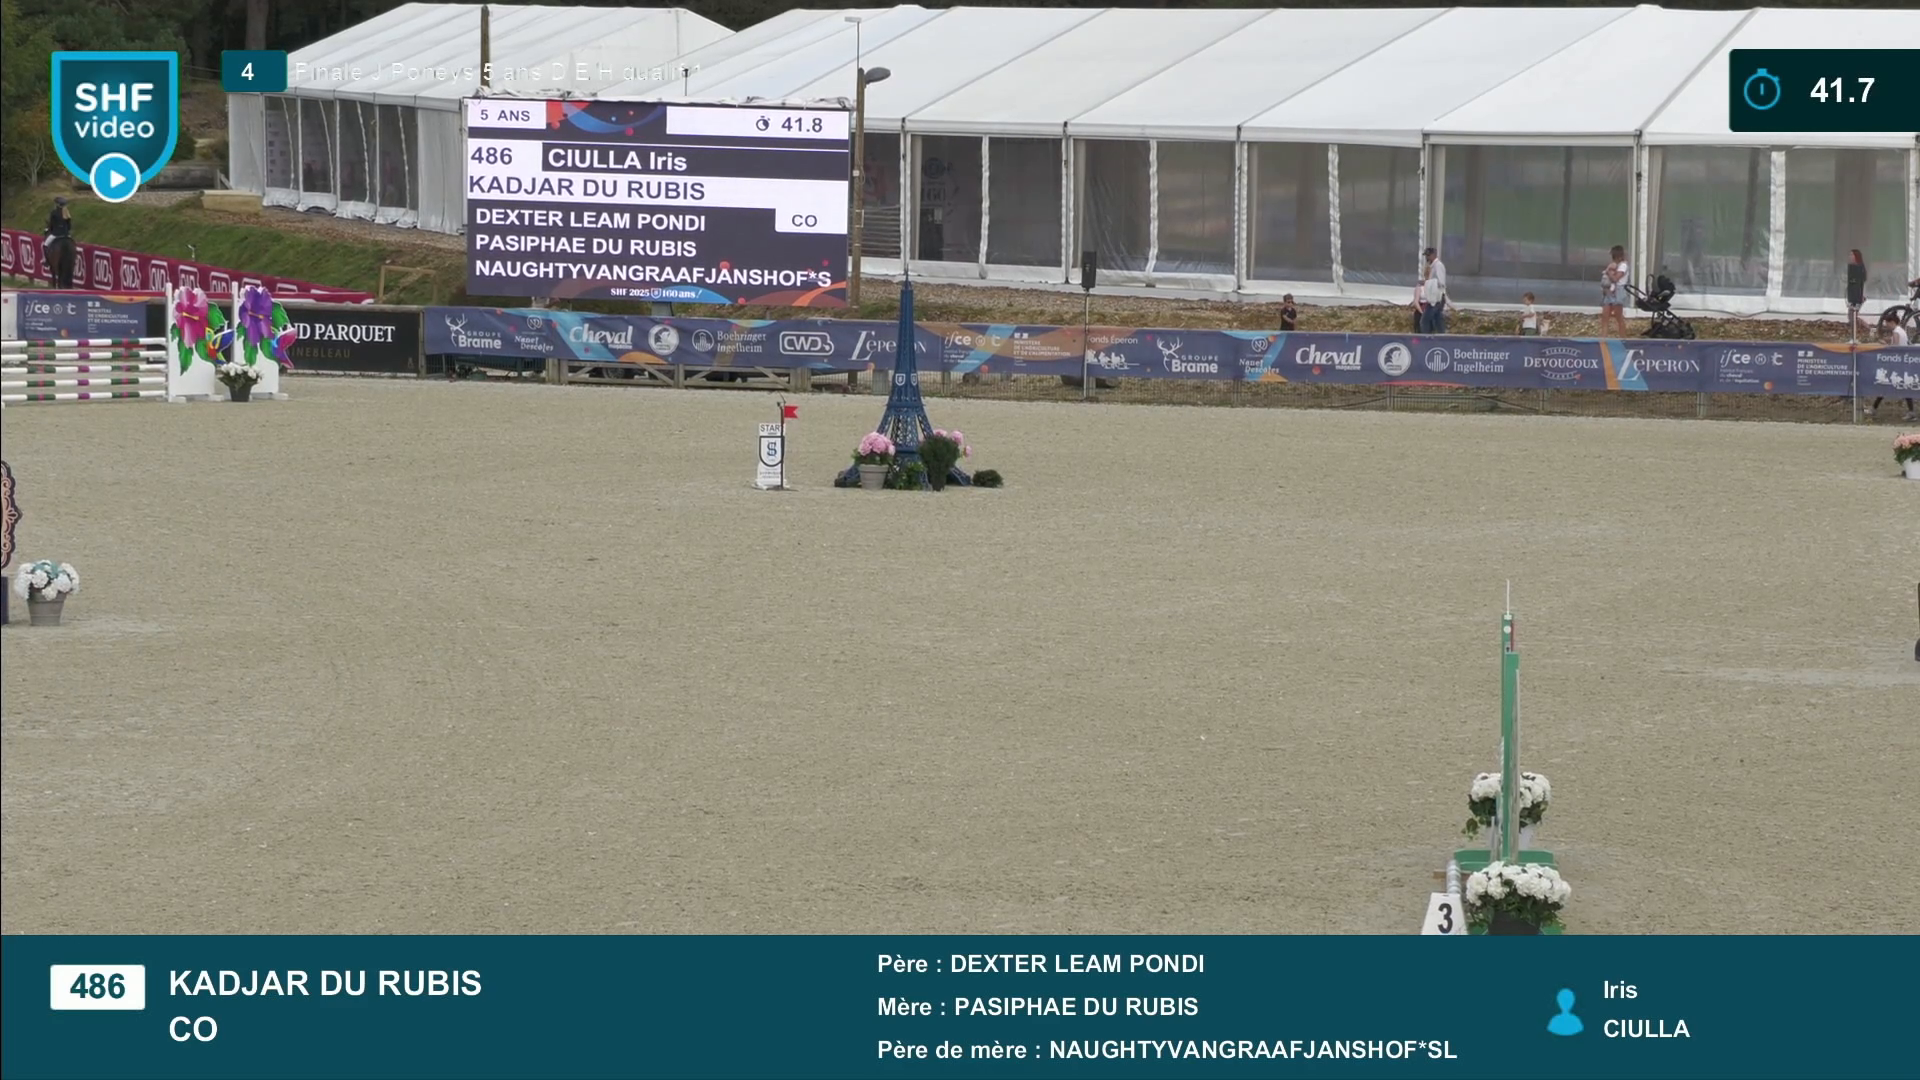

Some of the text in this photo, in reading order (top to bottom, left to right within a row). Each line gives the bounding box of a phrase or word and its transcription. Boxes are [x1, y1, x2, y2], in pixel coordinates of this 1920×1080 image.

[479, 109, 531, 122] 5 ANS
[781, 116, 823, 134] 41.8
[471, 146, 513, 165] 486
[548, 149, 688, 172] CIULLA Iris
[468, 175, 706, 201] KADJAR DU RUBIS
[475, 208, 706, 232] DEXTER LEAM PONDI
[791, 214, 818, 229] CO
[475, 234, 697, 258] PASIPHAE DU RUBIS
[610, 288, 628, 297] SHF
[629, 288, 650, 298] 2025
[313, 323, 396, 344] PARQUET
[569, 323, 634, 345] Cheval
[717, 331, 767, 343] Boehringer
[458, 335, 502, 349] Brame
[717, 342, 763, 354] Ingelheim
[784, 336, 823, 351] CWD
[1295, 344, 1362, 366] Cheval
[1453, 348, 1510, 362] Boehringer
[1720, 349, 1751, 368] ifce
[1876, 353, 1902, 363] Fonds
[1171, 361, 1219, 373] Brame
[1453, 362, 1505, 374] Ingelheim
[1437, 903, 1454, 934] 3
